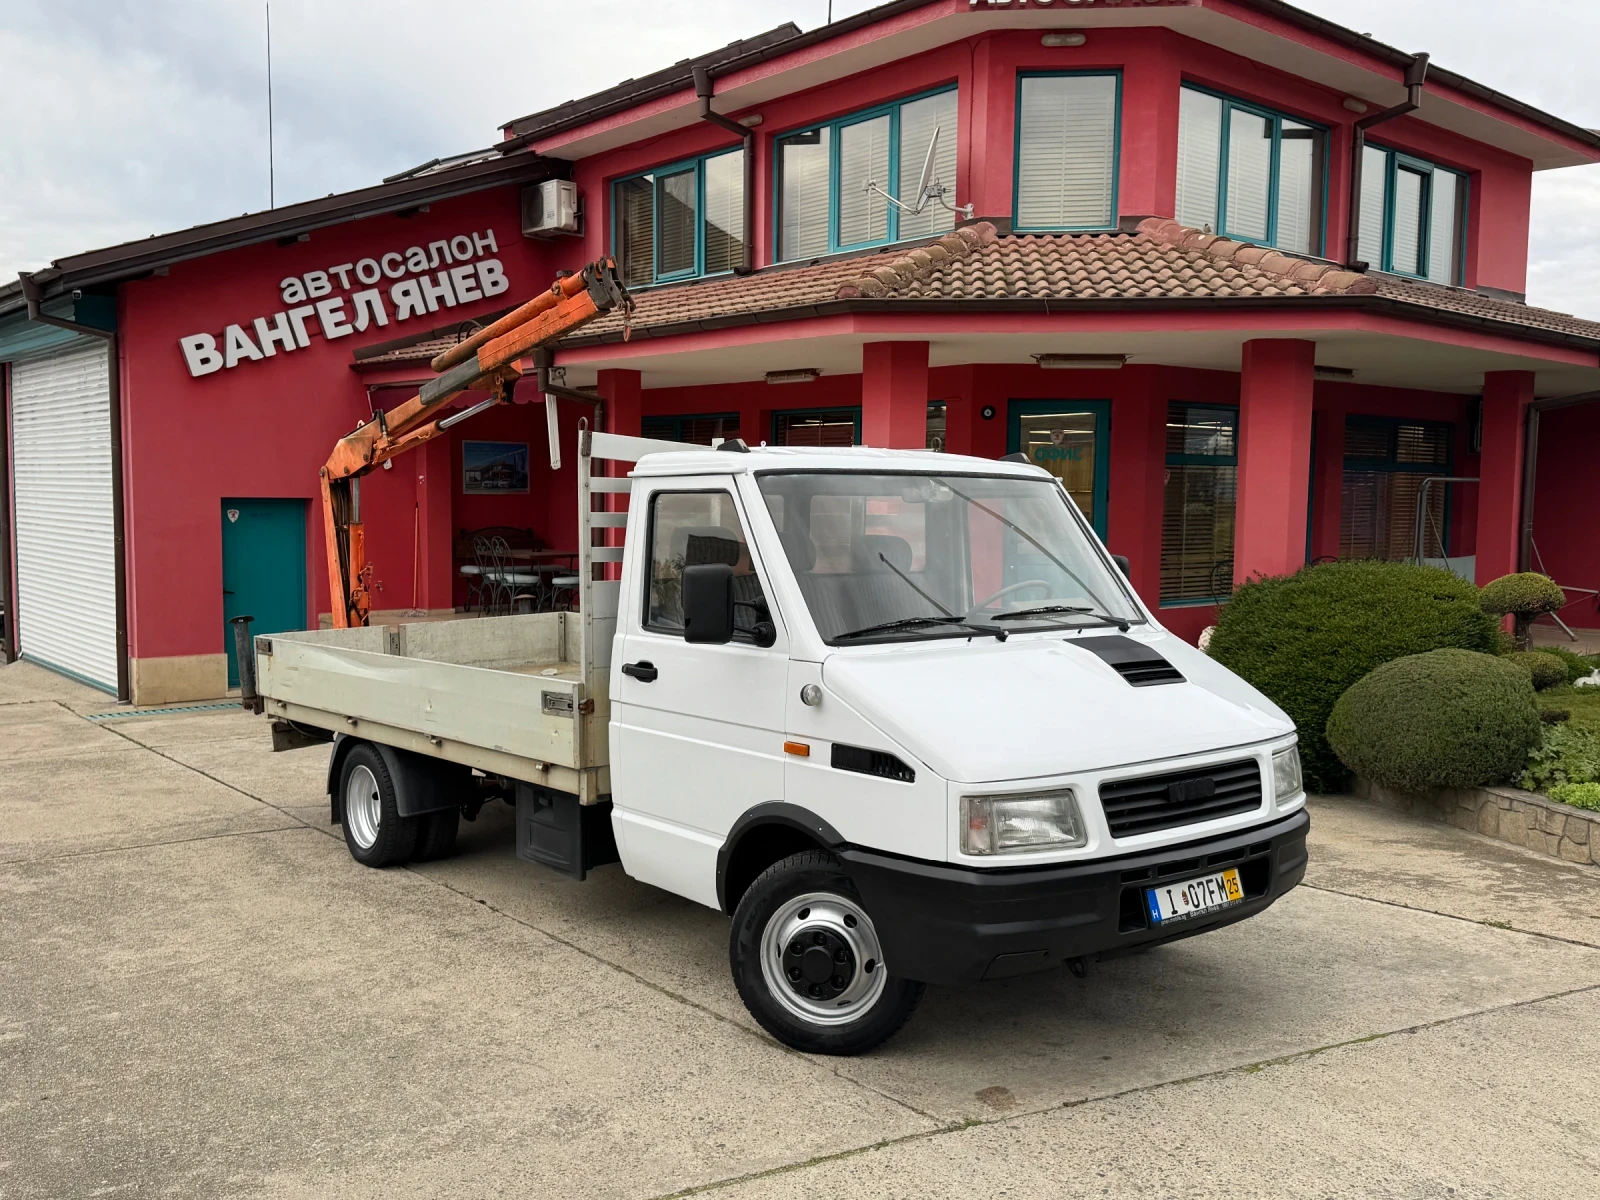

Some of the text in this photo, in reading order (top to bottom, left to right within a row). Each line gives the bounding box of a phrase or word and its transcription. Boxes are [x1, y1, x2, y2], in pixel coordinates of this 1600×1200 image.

[279, 228, 499, 305] автосалон
[178, 258, 510, 378] ВАНГЕЛ ЯНЕВ
[1226, 877, 1239, 895] 25
